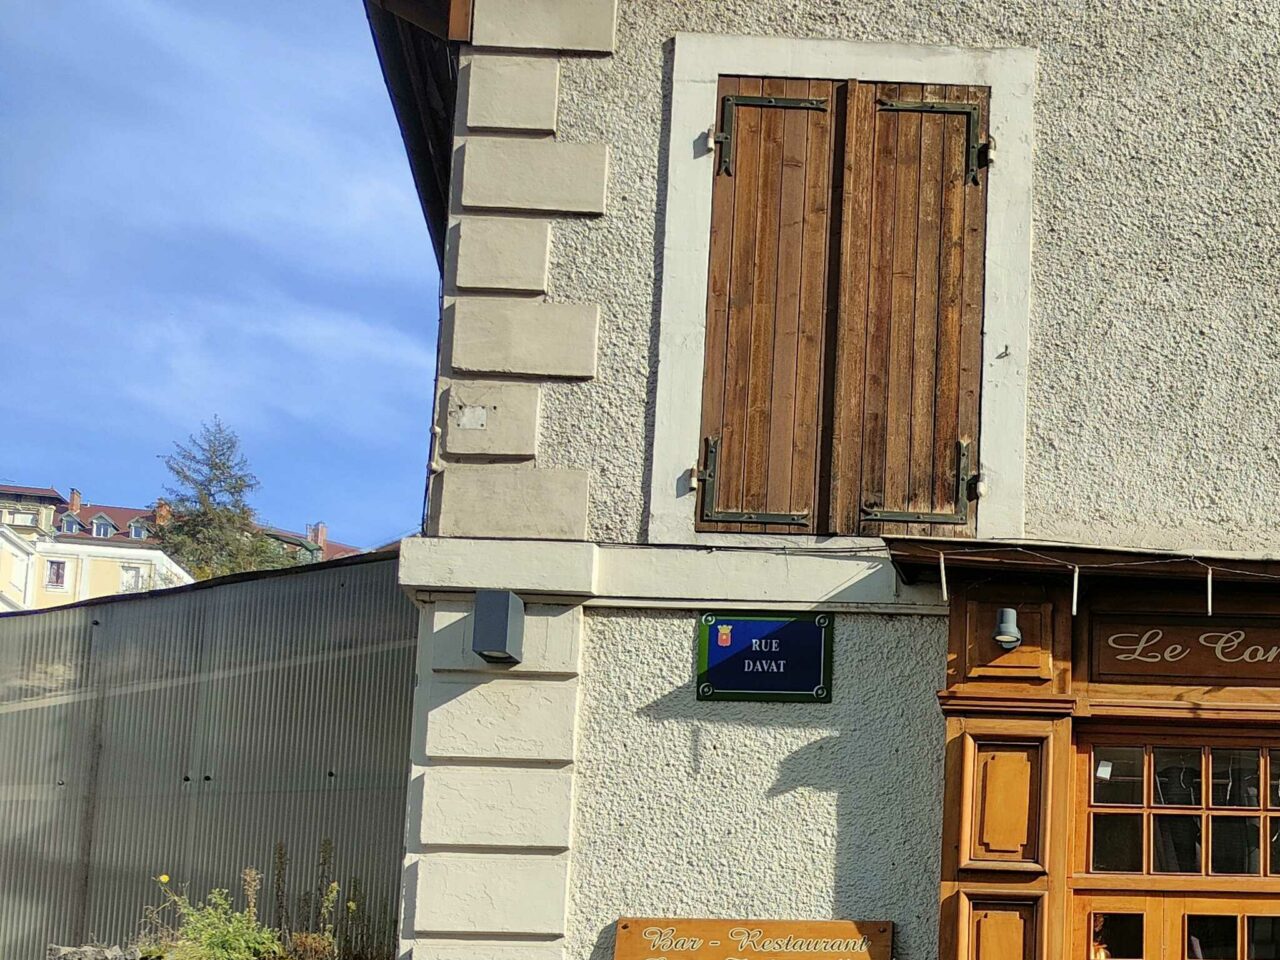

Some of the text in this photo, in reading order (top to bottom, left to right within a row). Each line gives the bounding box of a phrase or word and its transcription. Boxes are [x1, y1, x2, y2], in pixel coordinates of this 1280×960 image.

[751, 639, 780, 651] RUE
[1107, 629, 1191, 663] Le
[744, 659, 786, 672] DAVAT
[643, 927, 704, 952] Bar
[728, 928, 871, 953] Restaurant
